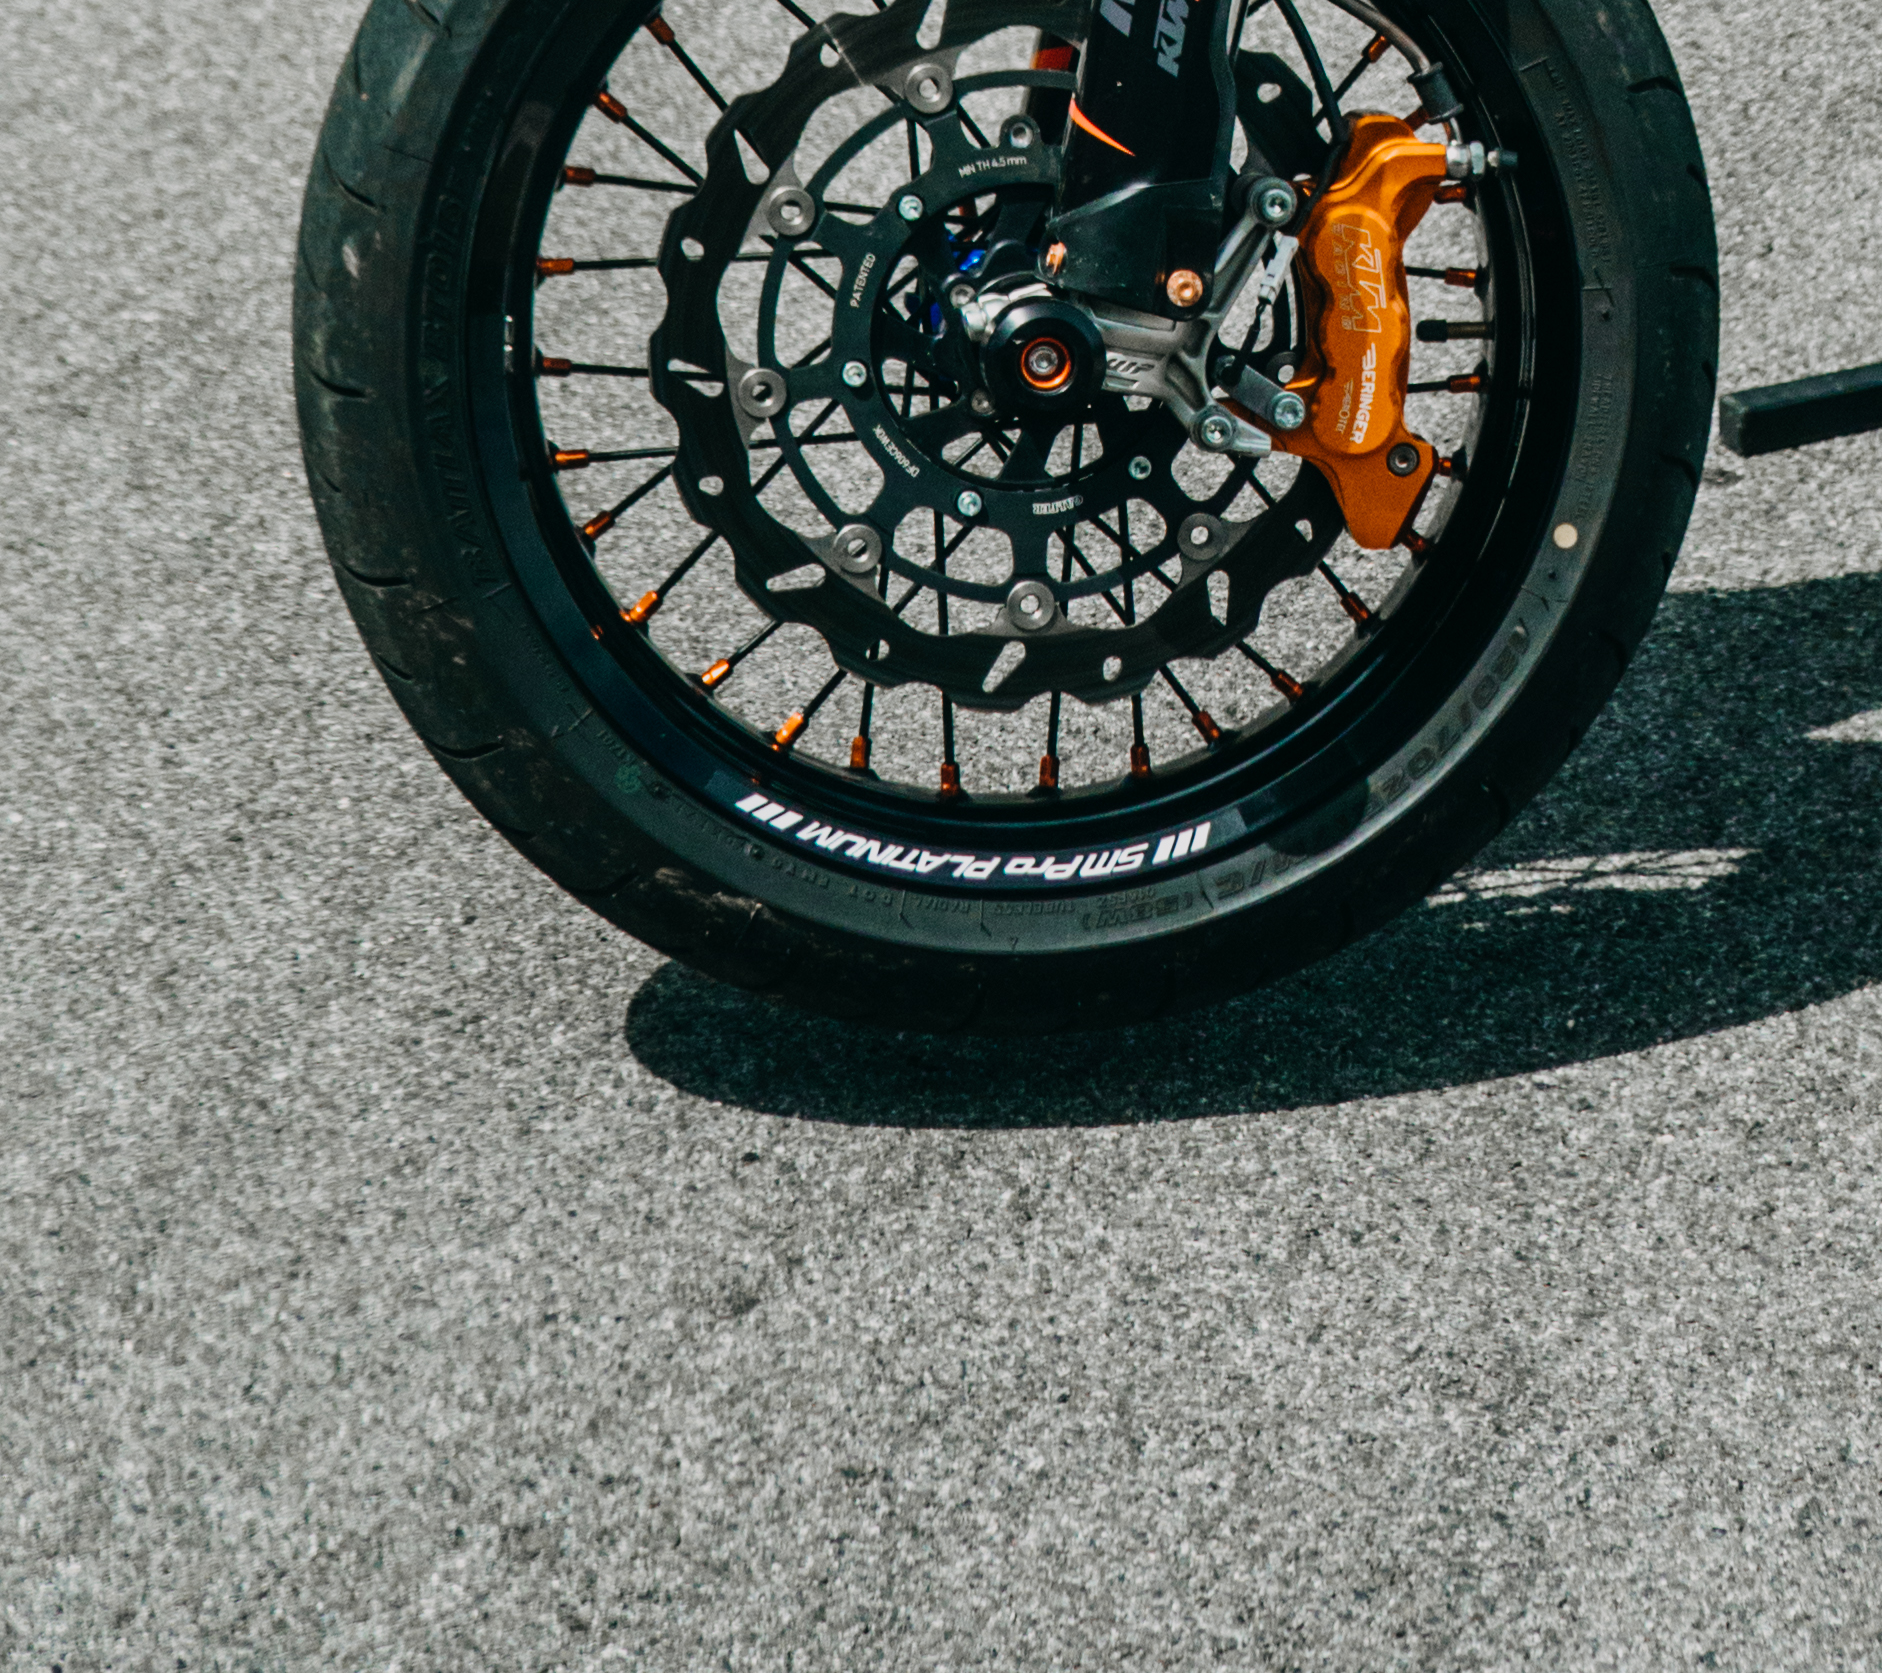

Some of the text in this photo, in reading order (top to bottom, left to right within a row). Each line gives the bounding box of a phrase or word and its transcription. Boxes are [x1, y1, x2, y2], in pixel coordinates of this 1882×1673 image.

[849, 251, 877, 309] PATENTED
[1342, 223, 1388, 334] KTM
[794, 817, 1003, 882] PLATINUM
